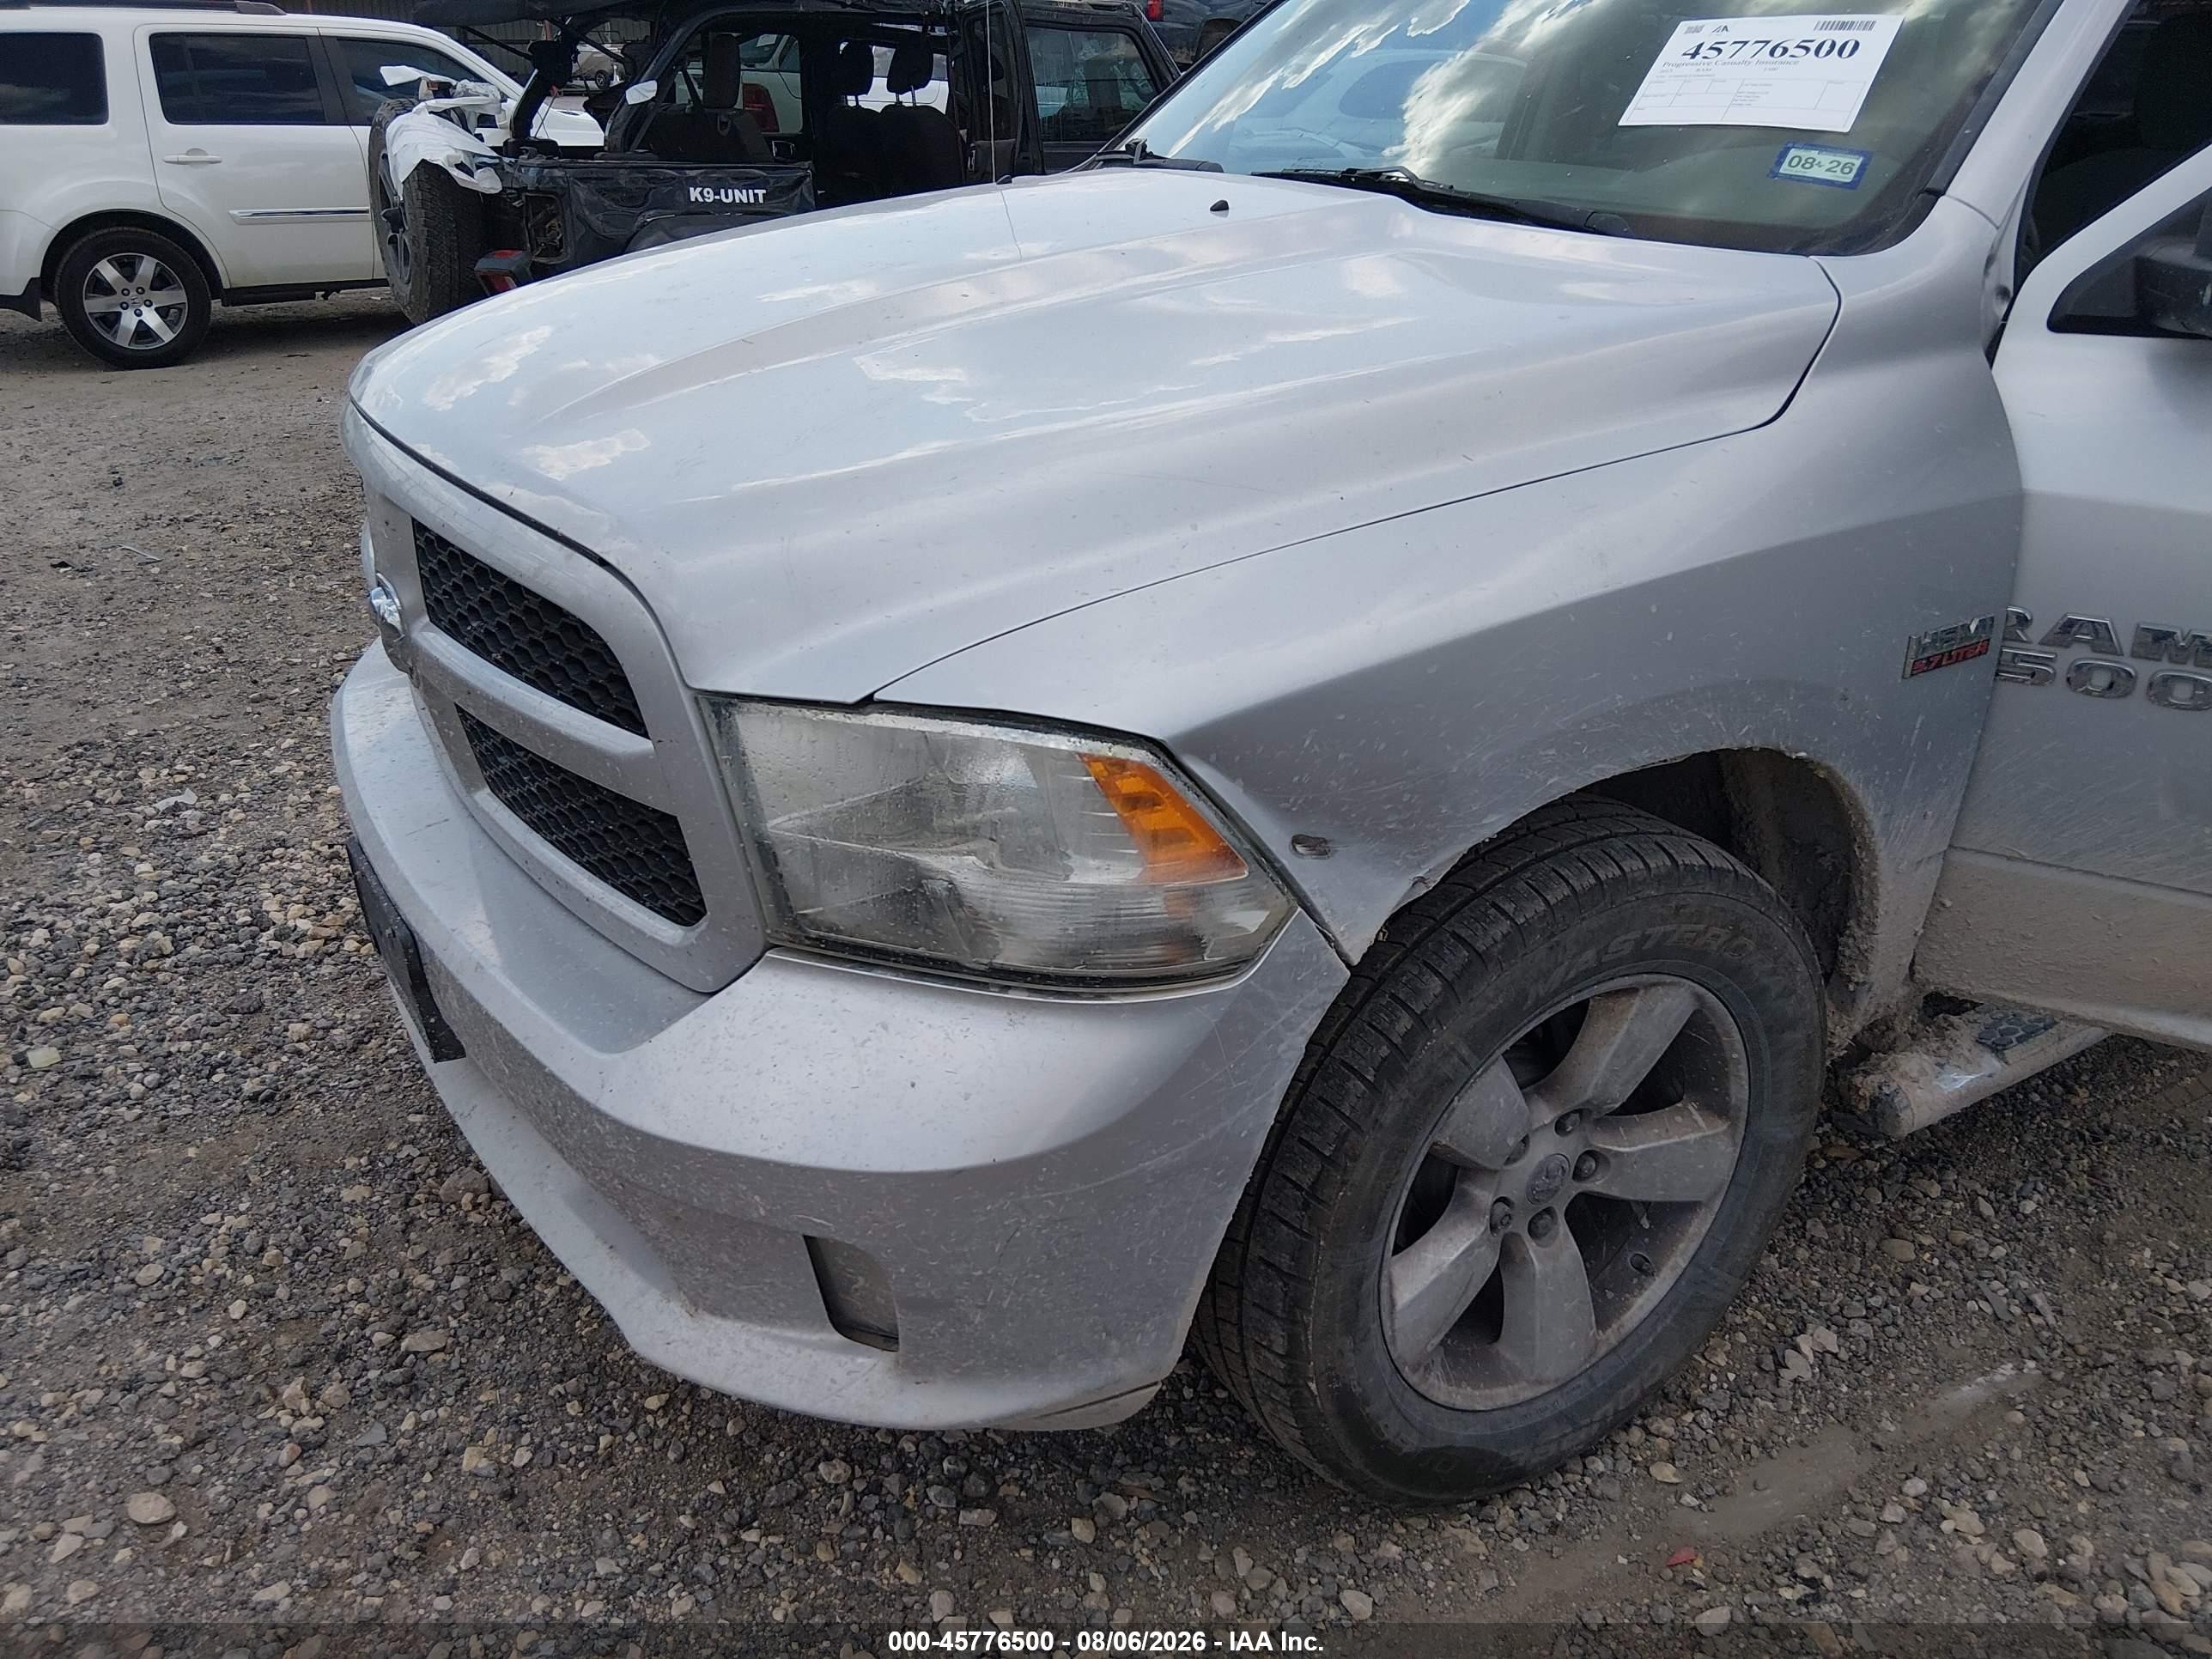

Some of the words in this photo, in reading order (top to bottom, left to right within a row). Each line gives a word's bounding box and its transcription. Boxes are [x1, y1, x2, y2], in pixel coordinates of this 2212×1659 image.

[1681, 38, 1861, 60] 45776500
[1787, 155, 1817, 170] 08
[1825, 160, 1856, 175] 26
[689, 186, 767, 204] K9-UNIT
[2001, 605, 2212, 669] RAM
